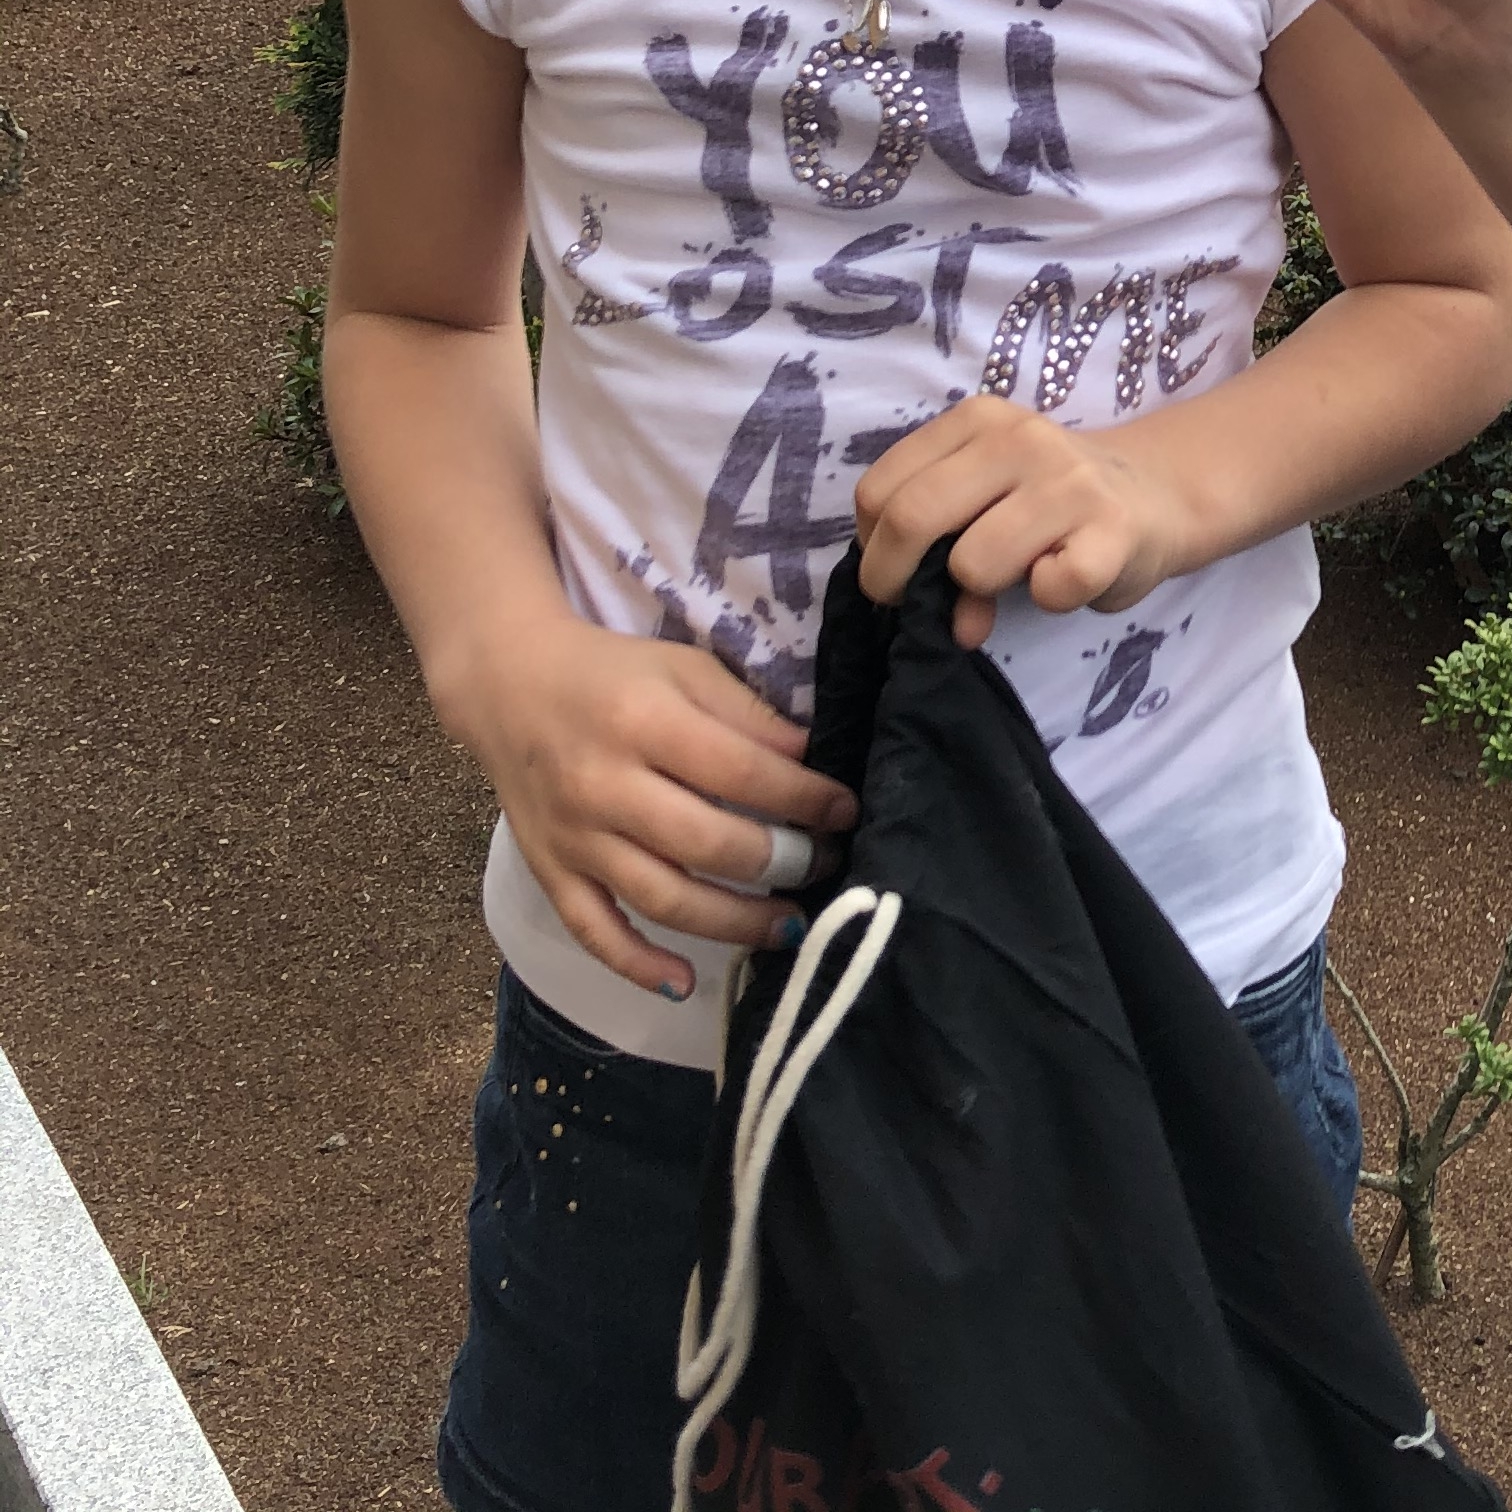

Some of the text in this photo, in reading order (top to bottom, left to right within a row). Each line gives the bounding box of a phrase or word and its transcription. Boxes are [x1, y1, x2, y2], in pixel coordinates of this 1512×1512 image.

[644, 2, 1084, 245] YOU
[562, 192, 1241, 416] LOST ME
